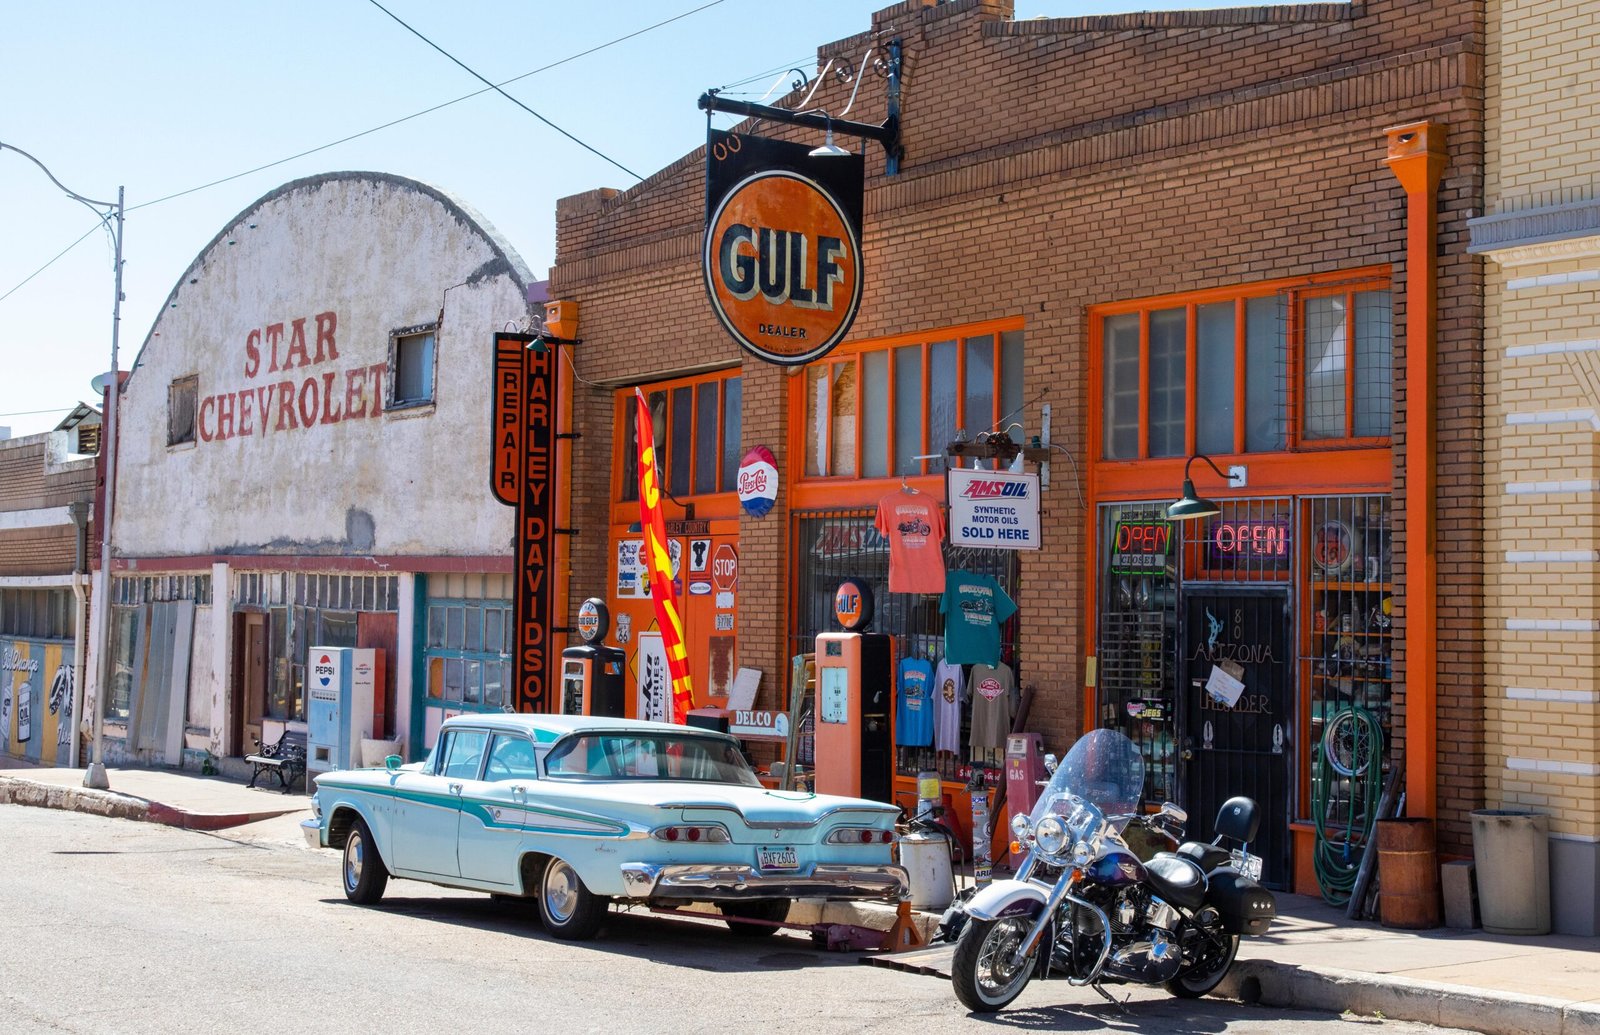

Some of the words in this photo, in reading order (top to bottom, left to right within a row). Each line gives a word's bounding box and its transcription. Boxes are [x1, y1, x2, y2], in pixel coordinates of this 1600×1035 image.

[719, 223, 847, 311] GULF
[759, 323, 806, 338] DEALER
[245, 311, 339, 379] STAR
[199, 361, 387, 442] CHEVROLET
[501, 371, 518, 489] REPAIR
[528, 351, 548, 505] HARLEY
[963, 480, 1027, 498] AMSOIL
[974, 505, 1015, 515] SYNTHETIC
[972, 515, 999, 524] MOTOR
[1001, 516, 1018, 525] OILS
[962, 526, 994, 538] SOLD
[998, 528, 1029, 540] HERE
[1117, 525, 1169, 551] OPEN
[1216, 524, 1284, 554] OPEN
[714, 559, 736, 576] STOP
[1121, 555, 1156, 564] CLOSED
[837, 594, 859, 614] GULF
[586, 617, 597, 625] GULF
[618, 631, 628, 641] 66
[1192, 642, 1275, 663] ARIZONA
[315, 666, 335, 675] PEPSI
[20, 707, 29, 720] OIL
[735, 710, 771, 726] DELCO
[1142, 708, 1161, 717] JEGS
[1009, 769, 1024, 780] GAS
